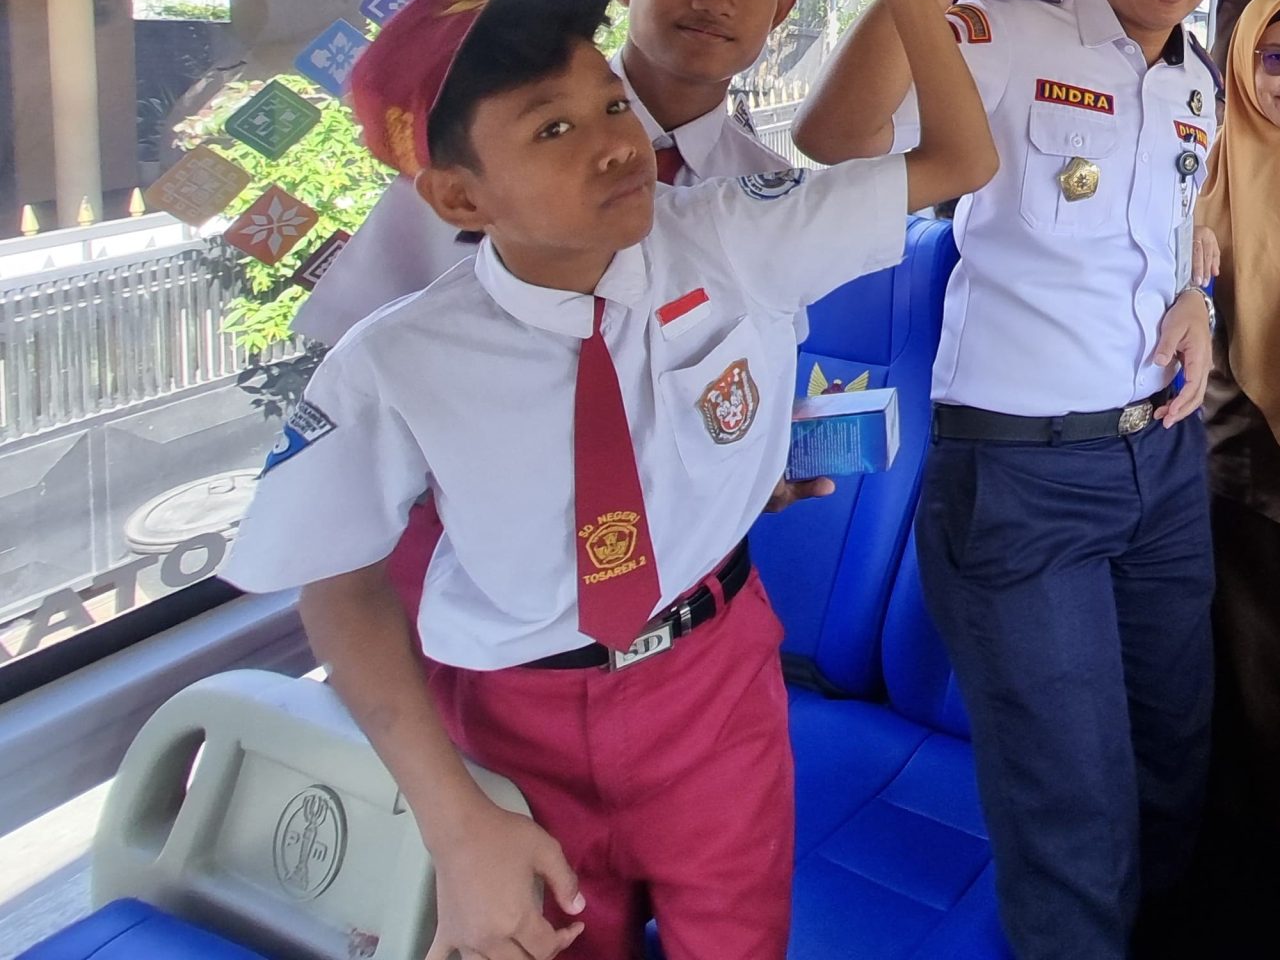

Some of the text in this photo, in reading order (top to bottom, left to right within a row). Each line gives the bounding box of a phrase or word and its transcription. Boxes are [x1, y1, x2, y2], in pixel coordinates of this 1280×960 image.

[1043, 82, 1110, 110] INDRA
[578, 511, 641, 539] SD NEGERI
[582, 555, 647, 585] TOSAREN 2
